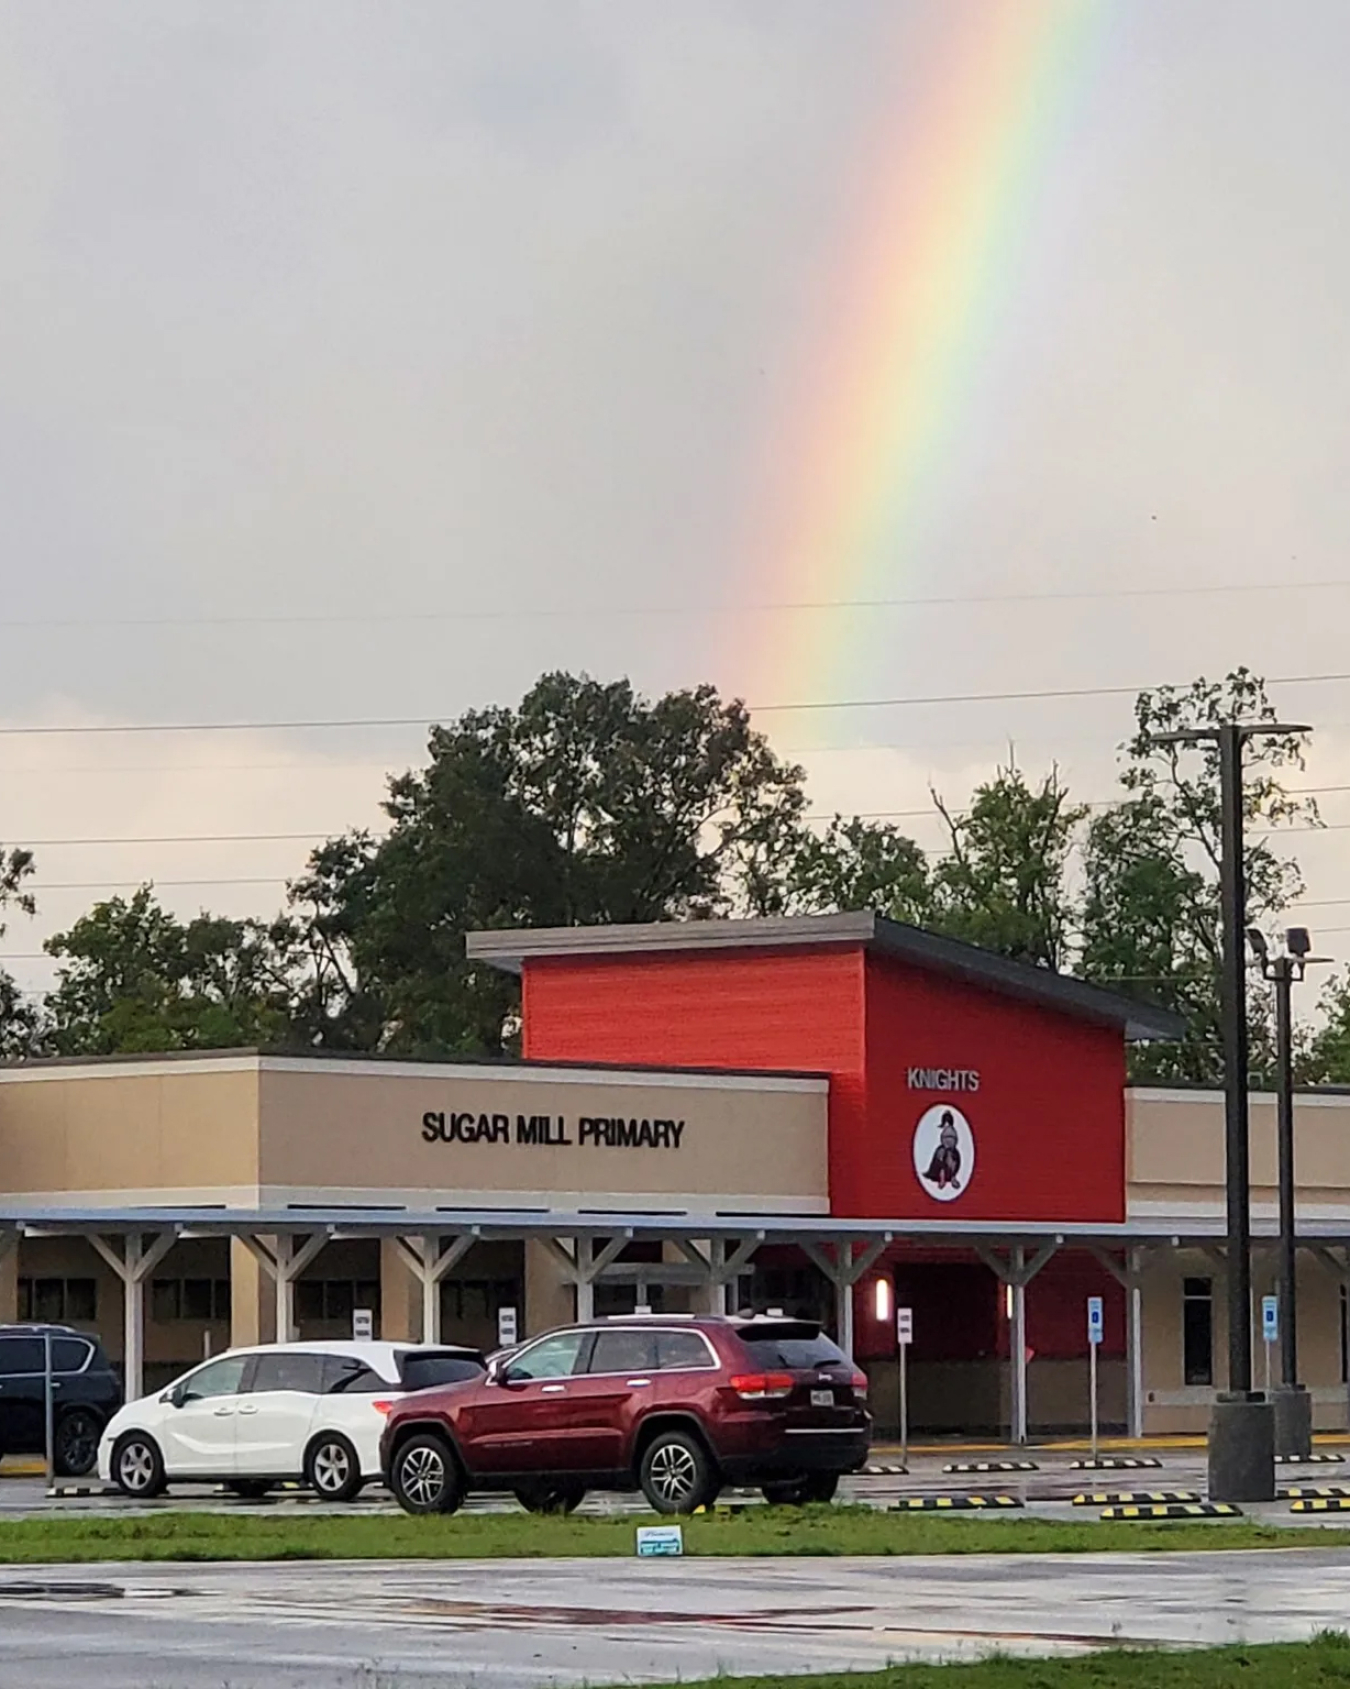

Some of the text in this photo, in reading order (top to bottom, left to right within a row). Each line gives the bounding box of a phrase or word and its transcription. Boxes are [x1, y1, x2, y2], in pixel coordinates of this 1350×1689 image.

[908, 1068, 980, 1092] KNIGHTS
[422, 1112, 685, 1148] SUGAR MILL PRIMARY
